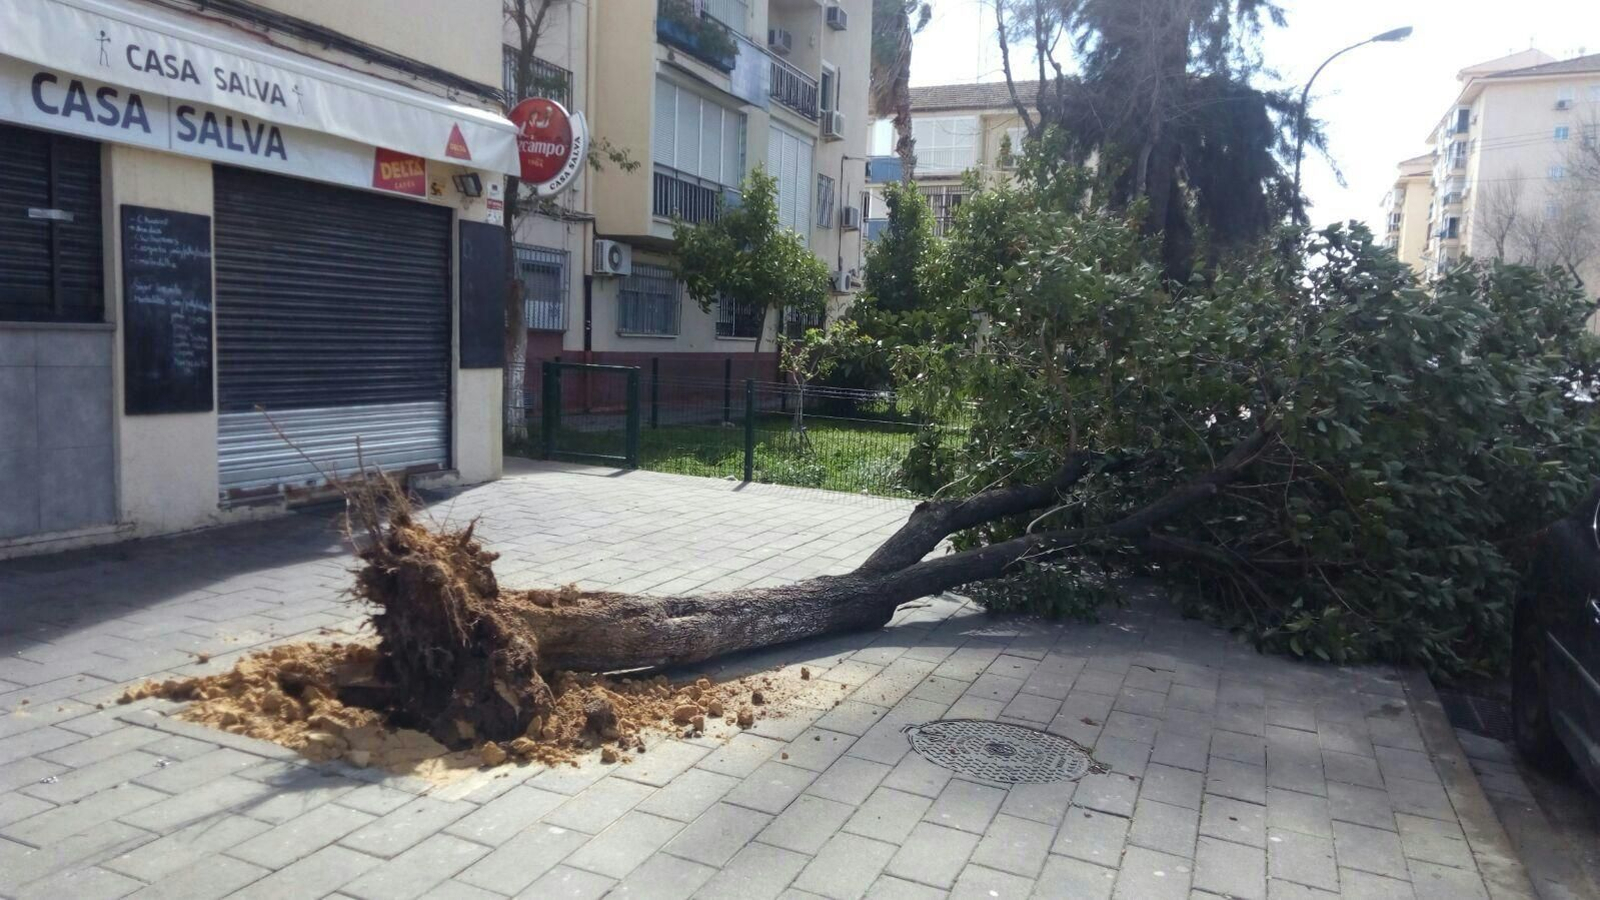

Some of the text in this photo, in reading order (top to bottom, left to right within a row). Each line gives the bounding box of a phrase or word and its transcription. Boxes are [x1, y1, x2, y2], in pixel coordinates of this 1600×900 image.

[126, 44, 287, 108] CASA SALVA
[31, 71, 288, 161] CASA SALVA
[379, 159, 425, 180] DELTA
[518, 140, 565, 157] zcampo
[549, 136, 581, 190] CASA SALVA
